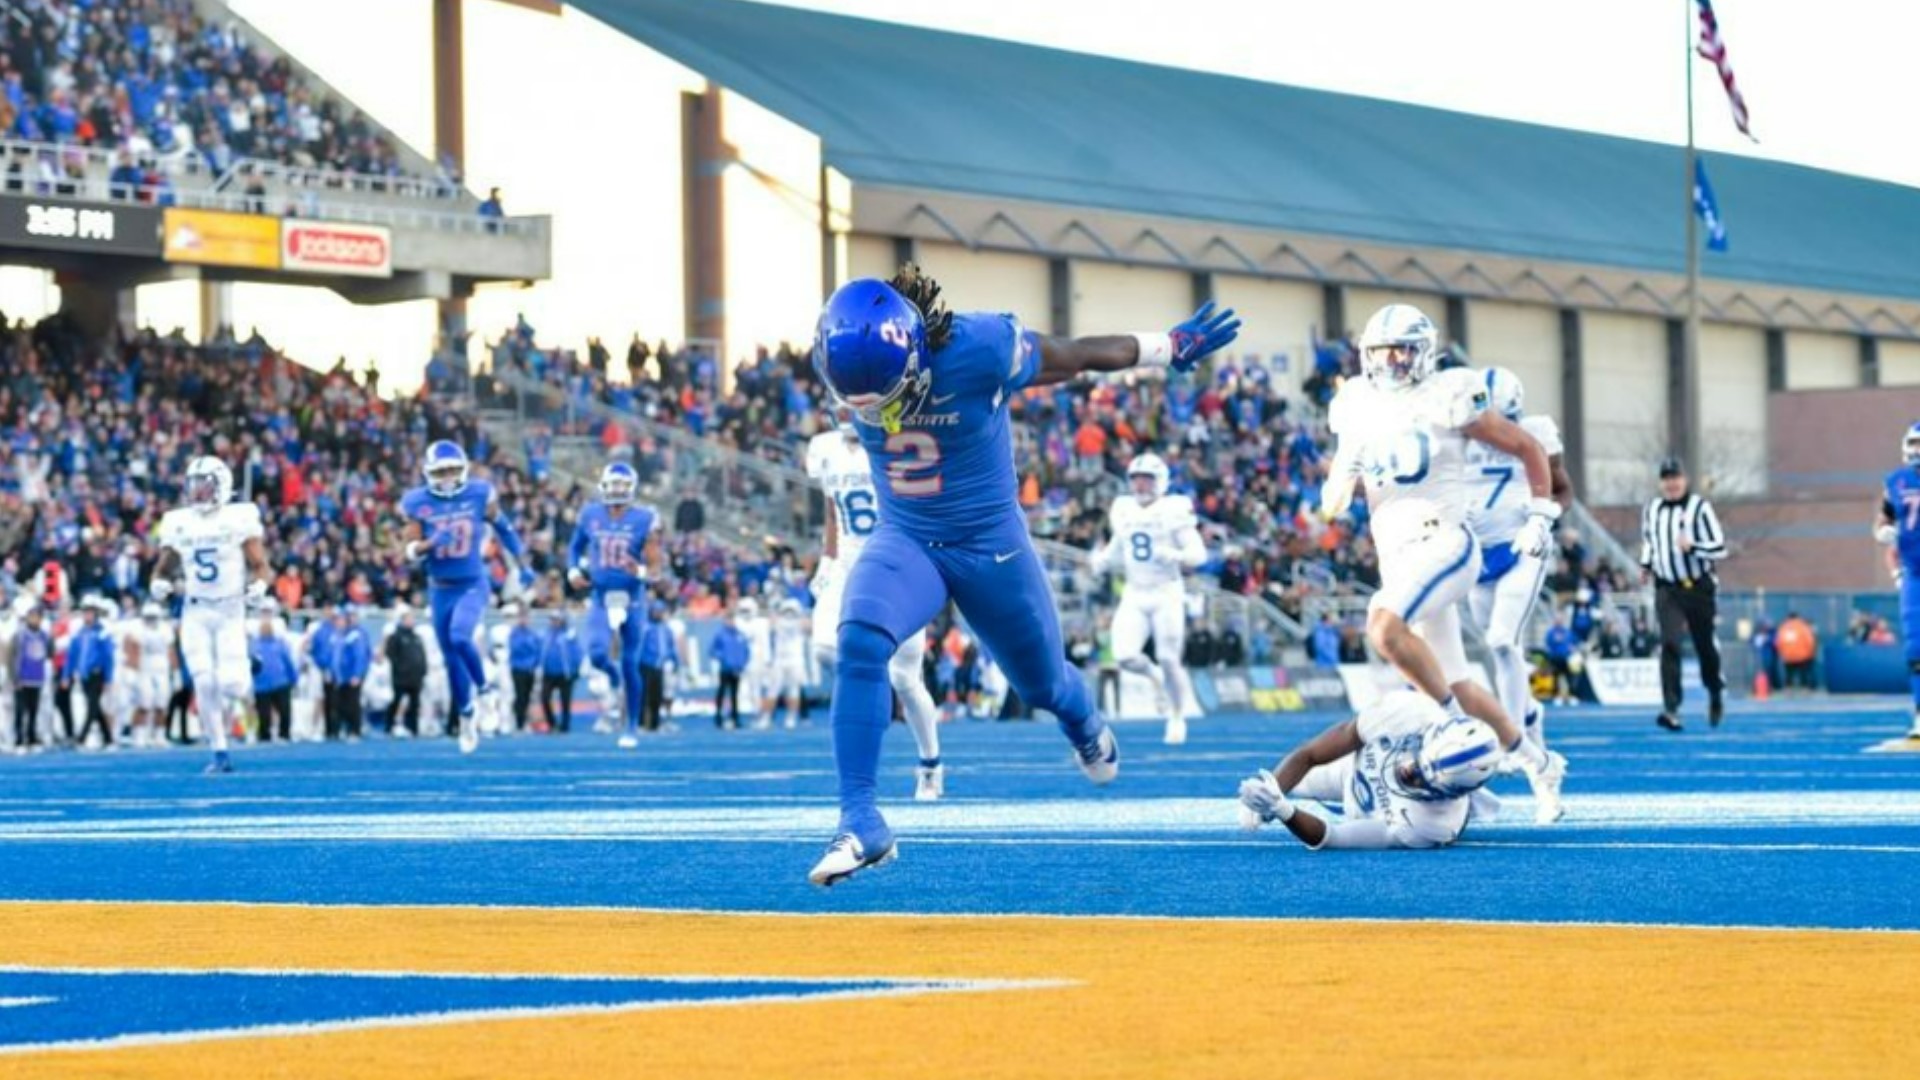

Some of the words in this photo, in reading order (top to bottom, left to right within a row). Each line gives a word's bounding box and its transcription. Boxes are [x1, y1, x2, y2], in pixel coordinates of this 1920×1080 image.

[78, 209, 114, 240] PM
[880, 319, 909, 350] 2
[885, 430, 943, 498] 2
[1481, 466, 1514, 511] 7
[834, 490, 878, 536] 16
[194, 547, 219, 582] 5
[1130, 531, 1152, 563] 8
